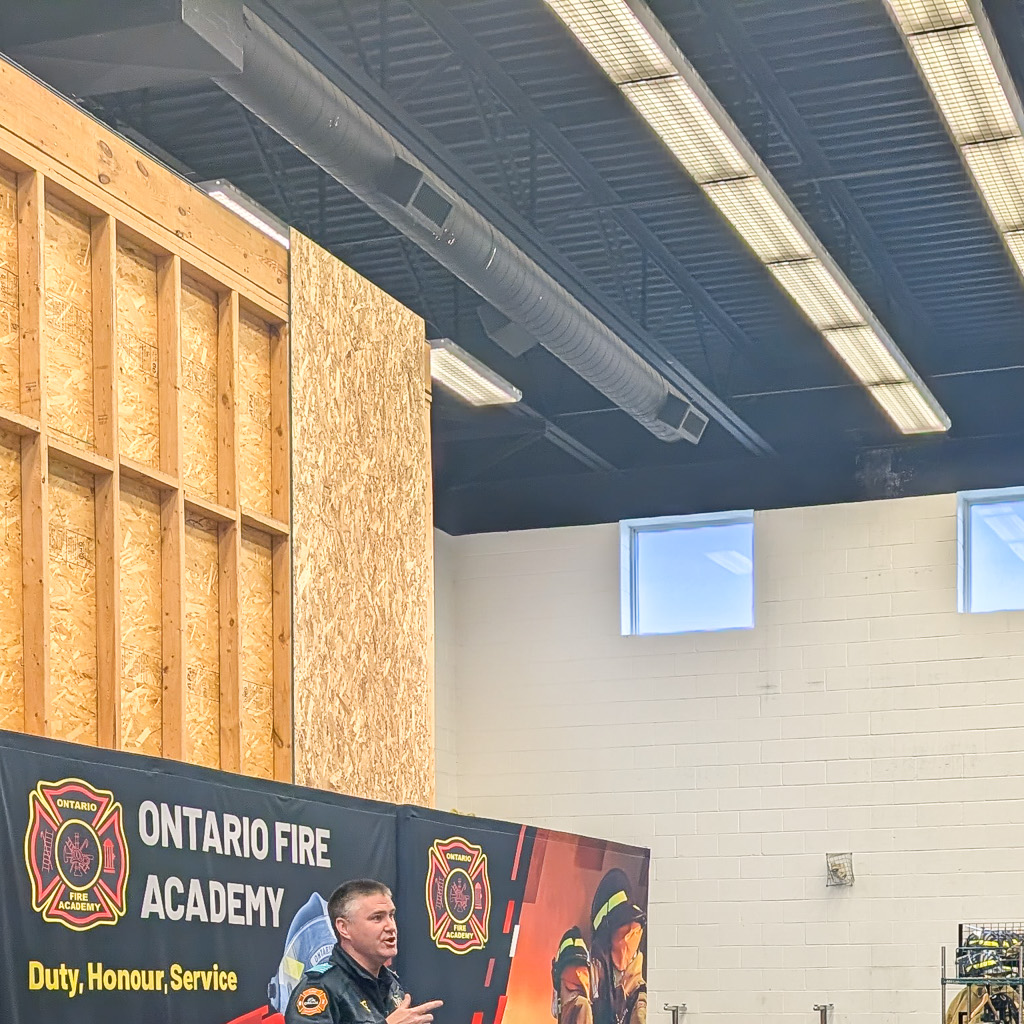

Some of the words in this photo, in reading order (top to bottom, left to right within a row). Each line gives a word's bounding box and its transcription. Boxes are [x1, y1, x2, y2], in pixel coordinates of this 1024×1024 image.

[56, 798, 98, 812] ONTARIO
[138, 800, 270, 861] ONTARIO
[275, 821, 331, 868] FIRE
[446, 852, 472, 863] ONTARIO
[69, 891, 89, 902] FIRE
[140, 874, 285, 928] ACADEMY
[58, 902, 101, 912] ACADEMY
[453, 924, 467, 932] FIRE
[445, 931, 474, 939] ACADEMY
[28, 960, 84, 998] Duty,
[88, 962, 168, 995] Honour,
[169, 963, 238, 992] Service
